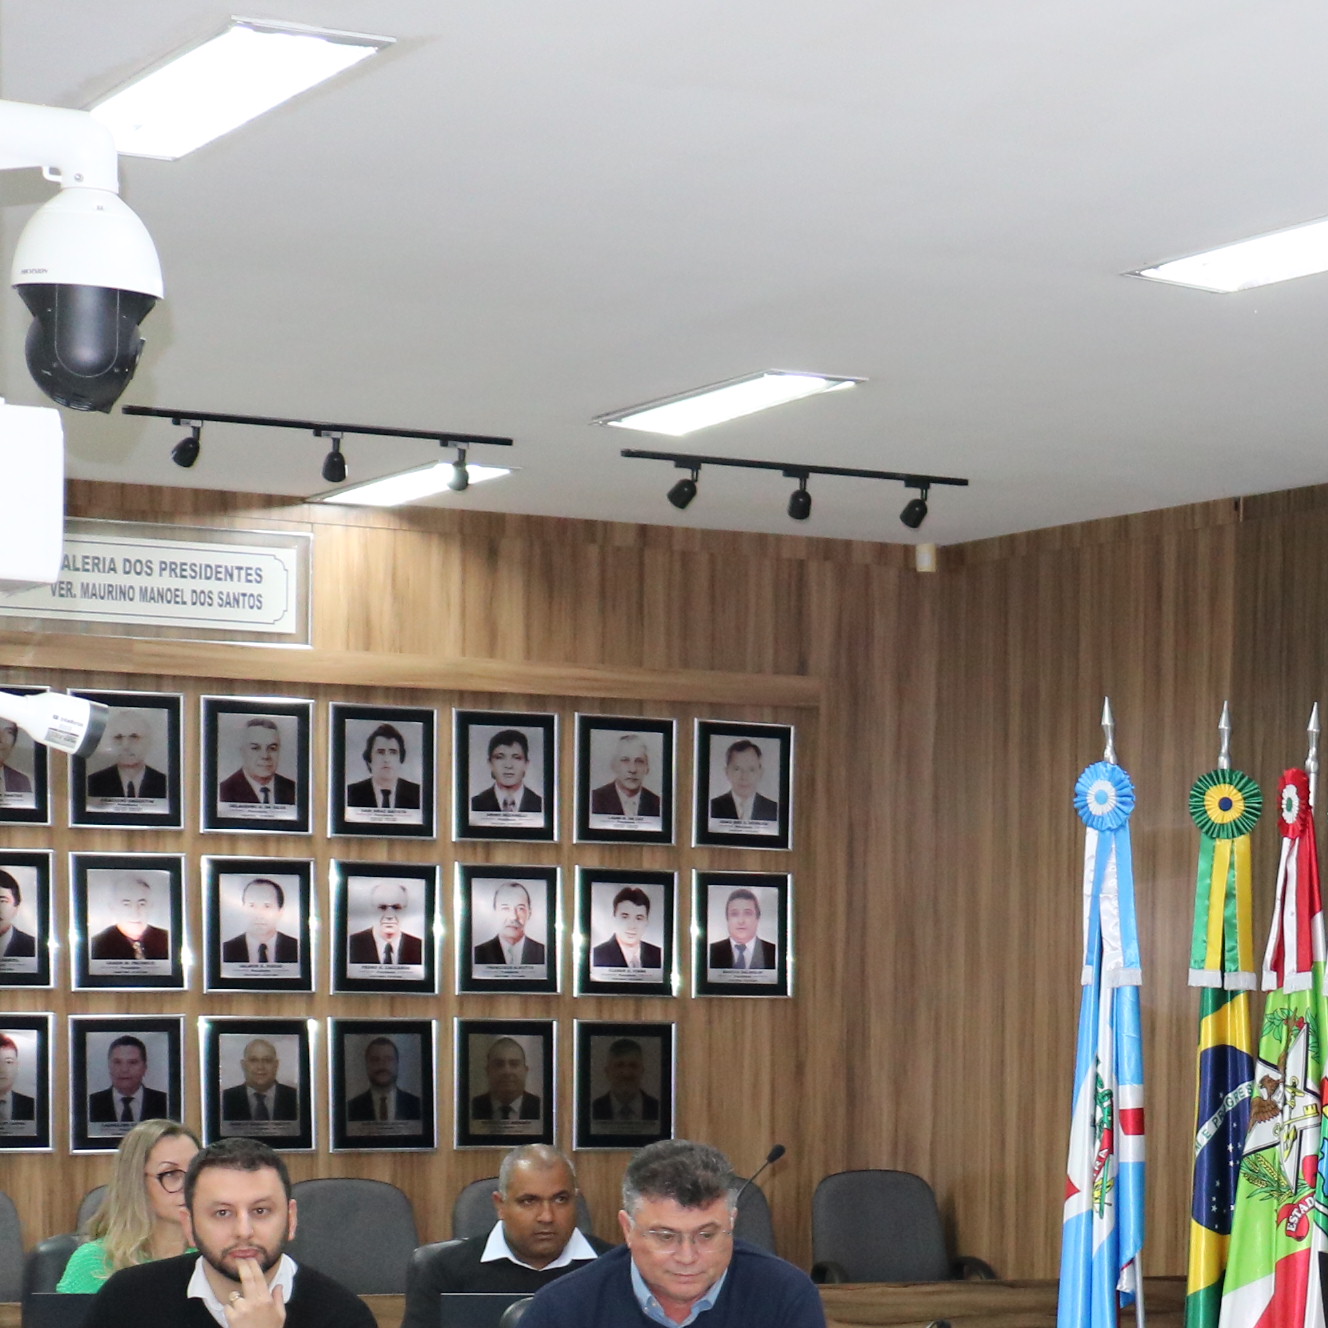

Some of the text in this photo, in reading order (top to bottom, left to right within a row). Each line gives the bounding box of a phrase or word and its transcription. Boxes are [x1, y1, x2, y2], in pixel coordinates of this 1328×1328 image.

[62, 553, 263, 584] ALERIA DOS PRESIDENTES
[81, 584, 135, 602] MAURINO
[139, 587, 187, 606] MANOEL
[191, 589, 213, 607] DOS
[217, 592, 263, 610] SANTOS
[1287, 1196, 1315, 1231] ESTAD
